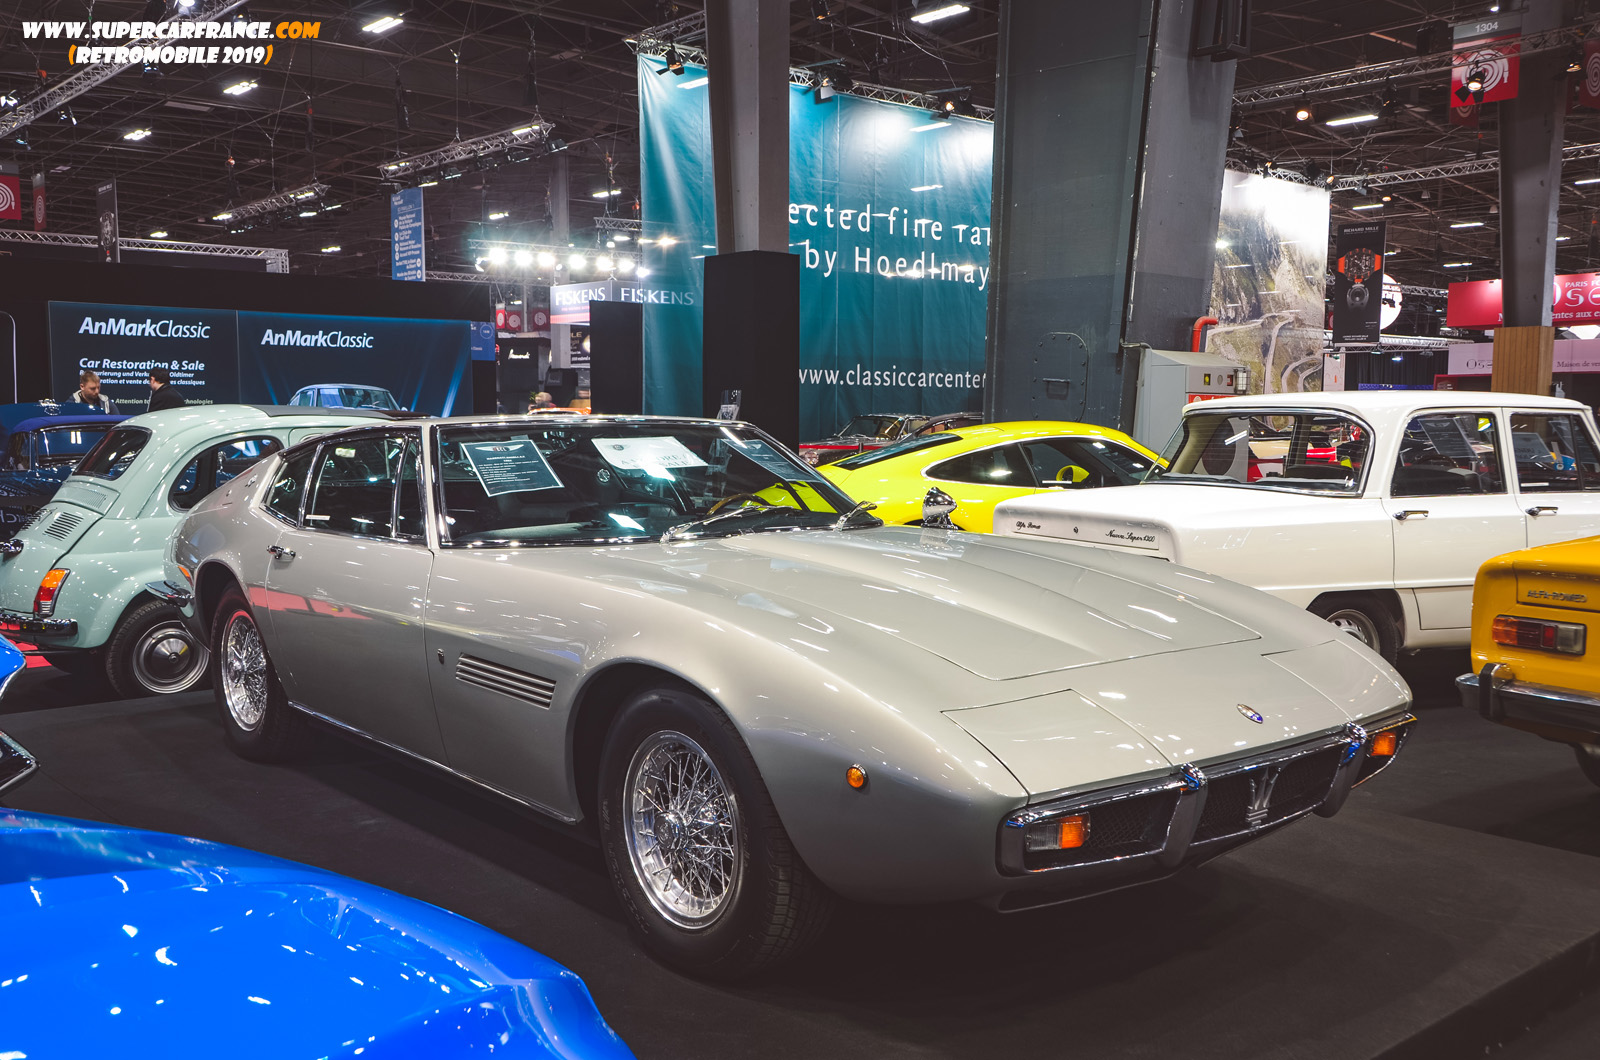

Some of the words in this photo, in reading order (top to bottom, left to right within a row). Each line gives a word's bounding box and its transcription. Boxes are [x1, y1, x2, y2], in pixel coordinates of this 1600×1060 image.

[1475, 21, 1499, 33] 1304
[888, 206, 943, 241] fine
[805, 238, 837, 278] by
[555, 287, 606, 306] FISKENS
[620, 287, 694, 306] FISKENS
[78, 317, 211, 339] AnMarkClassic
[260, 329, 375, 349] AnMarkClassic
[79, 358, 100, 369] Car
[102, 358, 169, 370] Restoration
[170, 360, 180, 371] &
[181, 360, 205, 372] Sale
